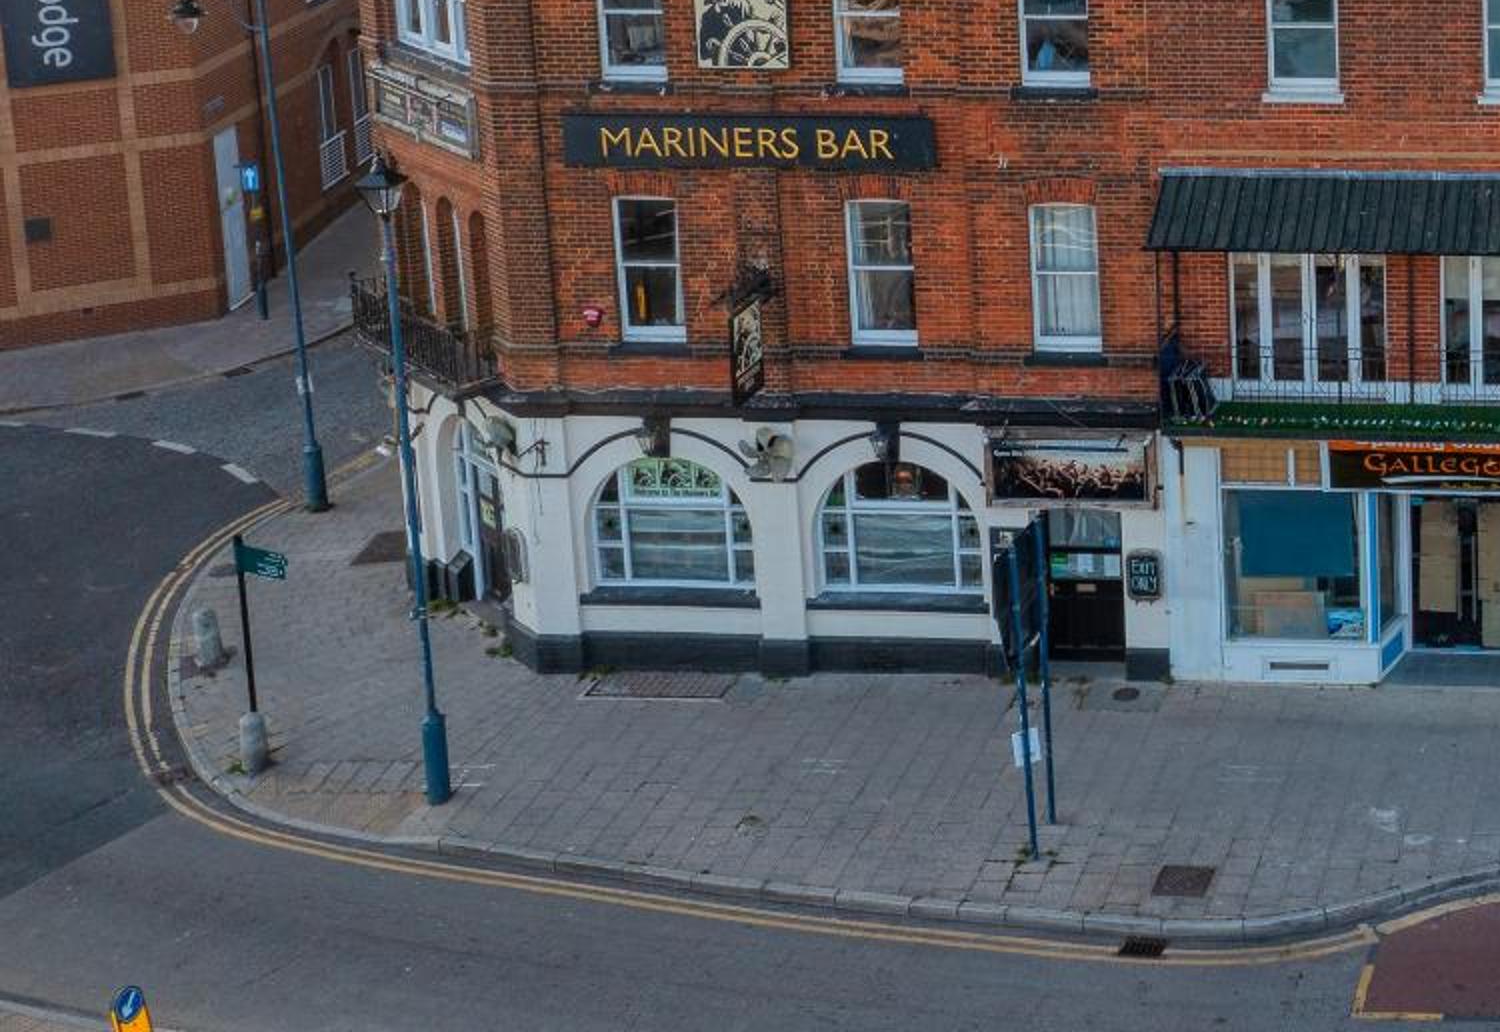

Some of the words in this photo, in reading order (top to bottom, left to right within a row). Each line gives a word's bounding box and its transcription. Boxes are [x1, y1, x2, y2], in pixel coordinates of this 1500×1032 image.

[599, 126, 800, 160] MARINERS
[816, 128, 896, 160] BAR
[1131, 559, 1155, 576] EXIT
[1131, 575, 1157, 593] ONLY
